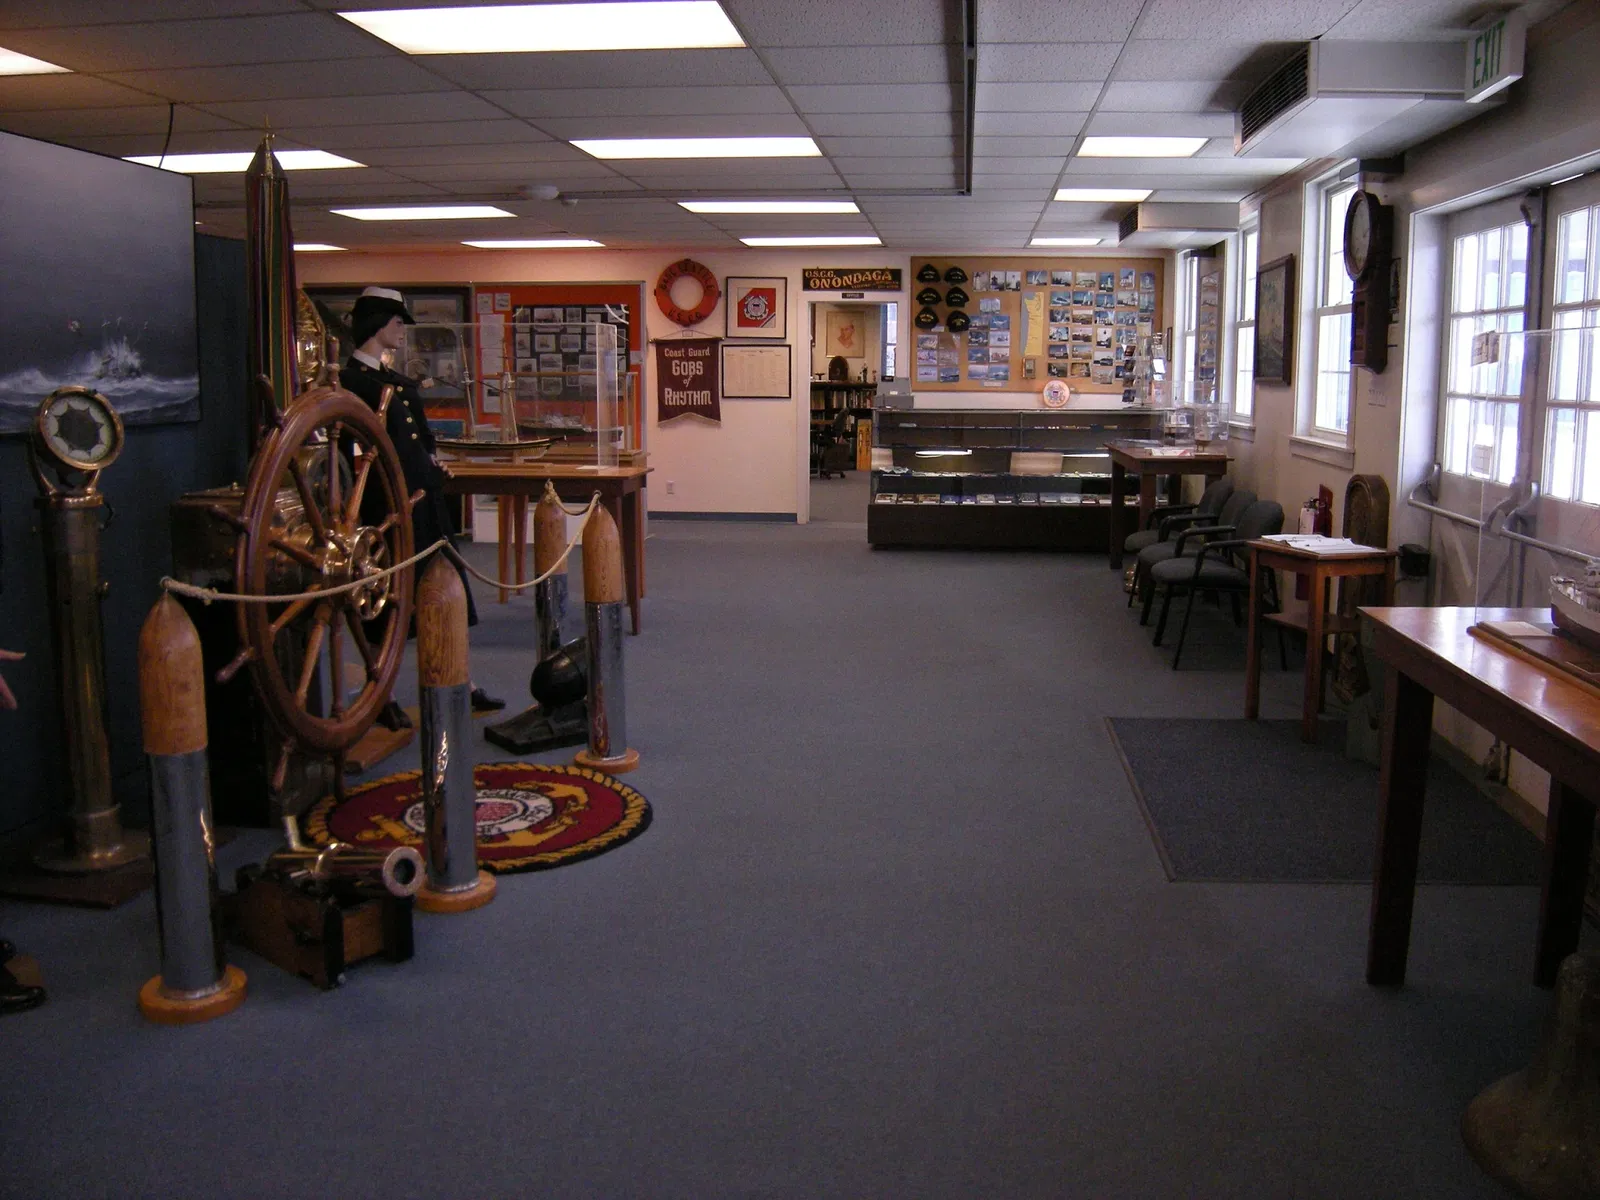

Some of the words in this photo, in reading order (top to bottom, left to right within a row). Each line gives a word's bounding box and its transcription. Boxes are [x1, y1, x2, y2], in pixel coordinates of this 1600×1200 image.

[1473, 20, 1505, 89] EXIT
[810, 270, 893, 289] ONONDAGA
[664, 347, 685, 357] Coast
[688, 347, 710, 357] Guard
[683, 376, 692, 388] of
